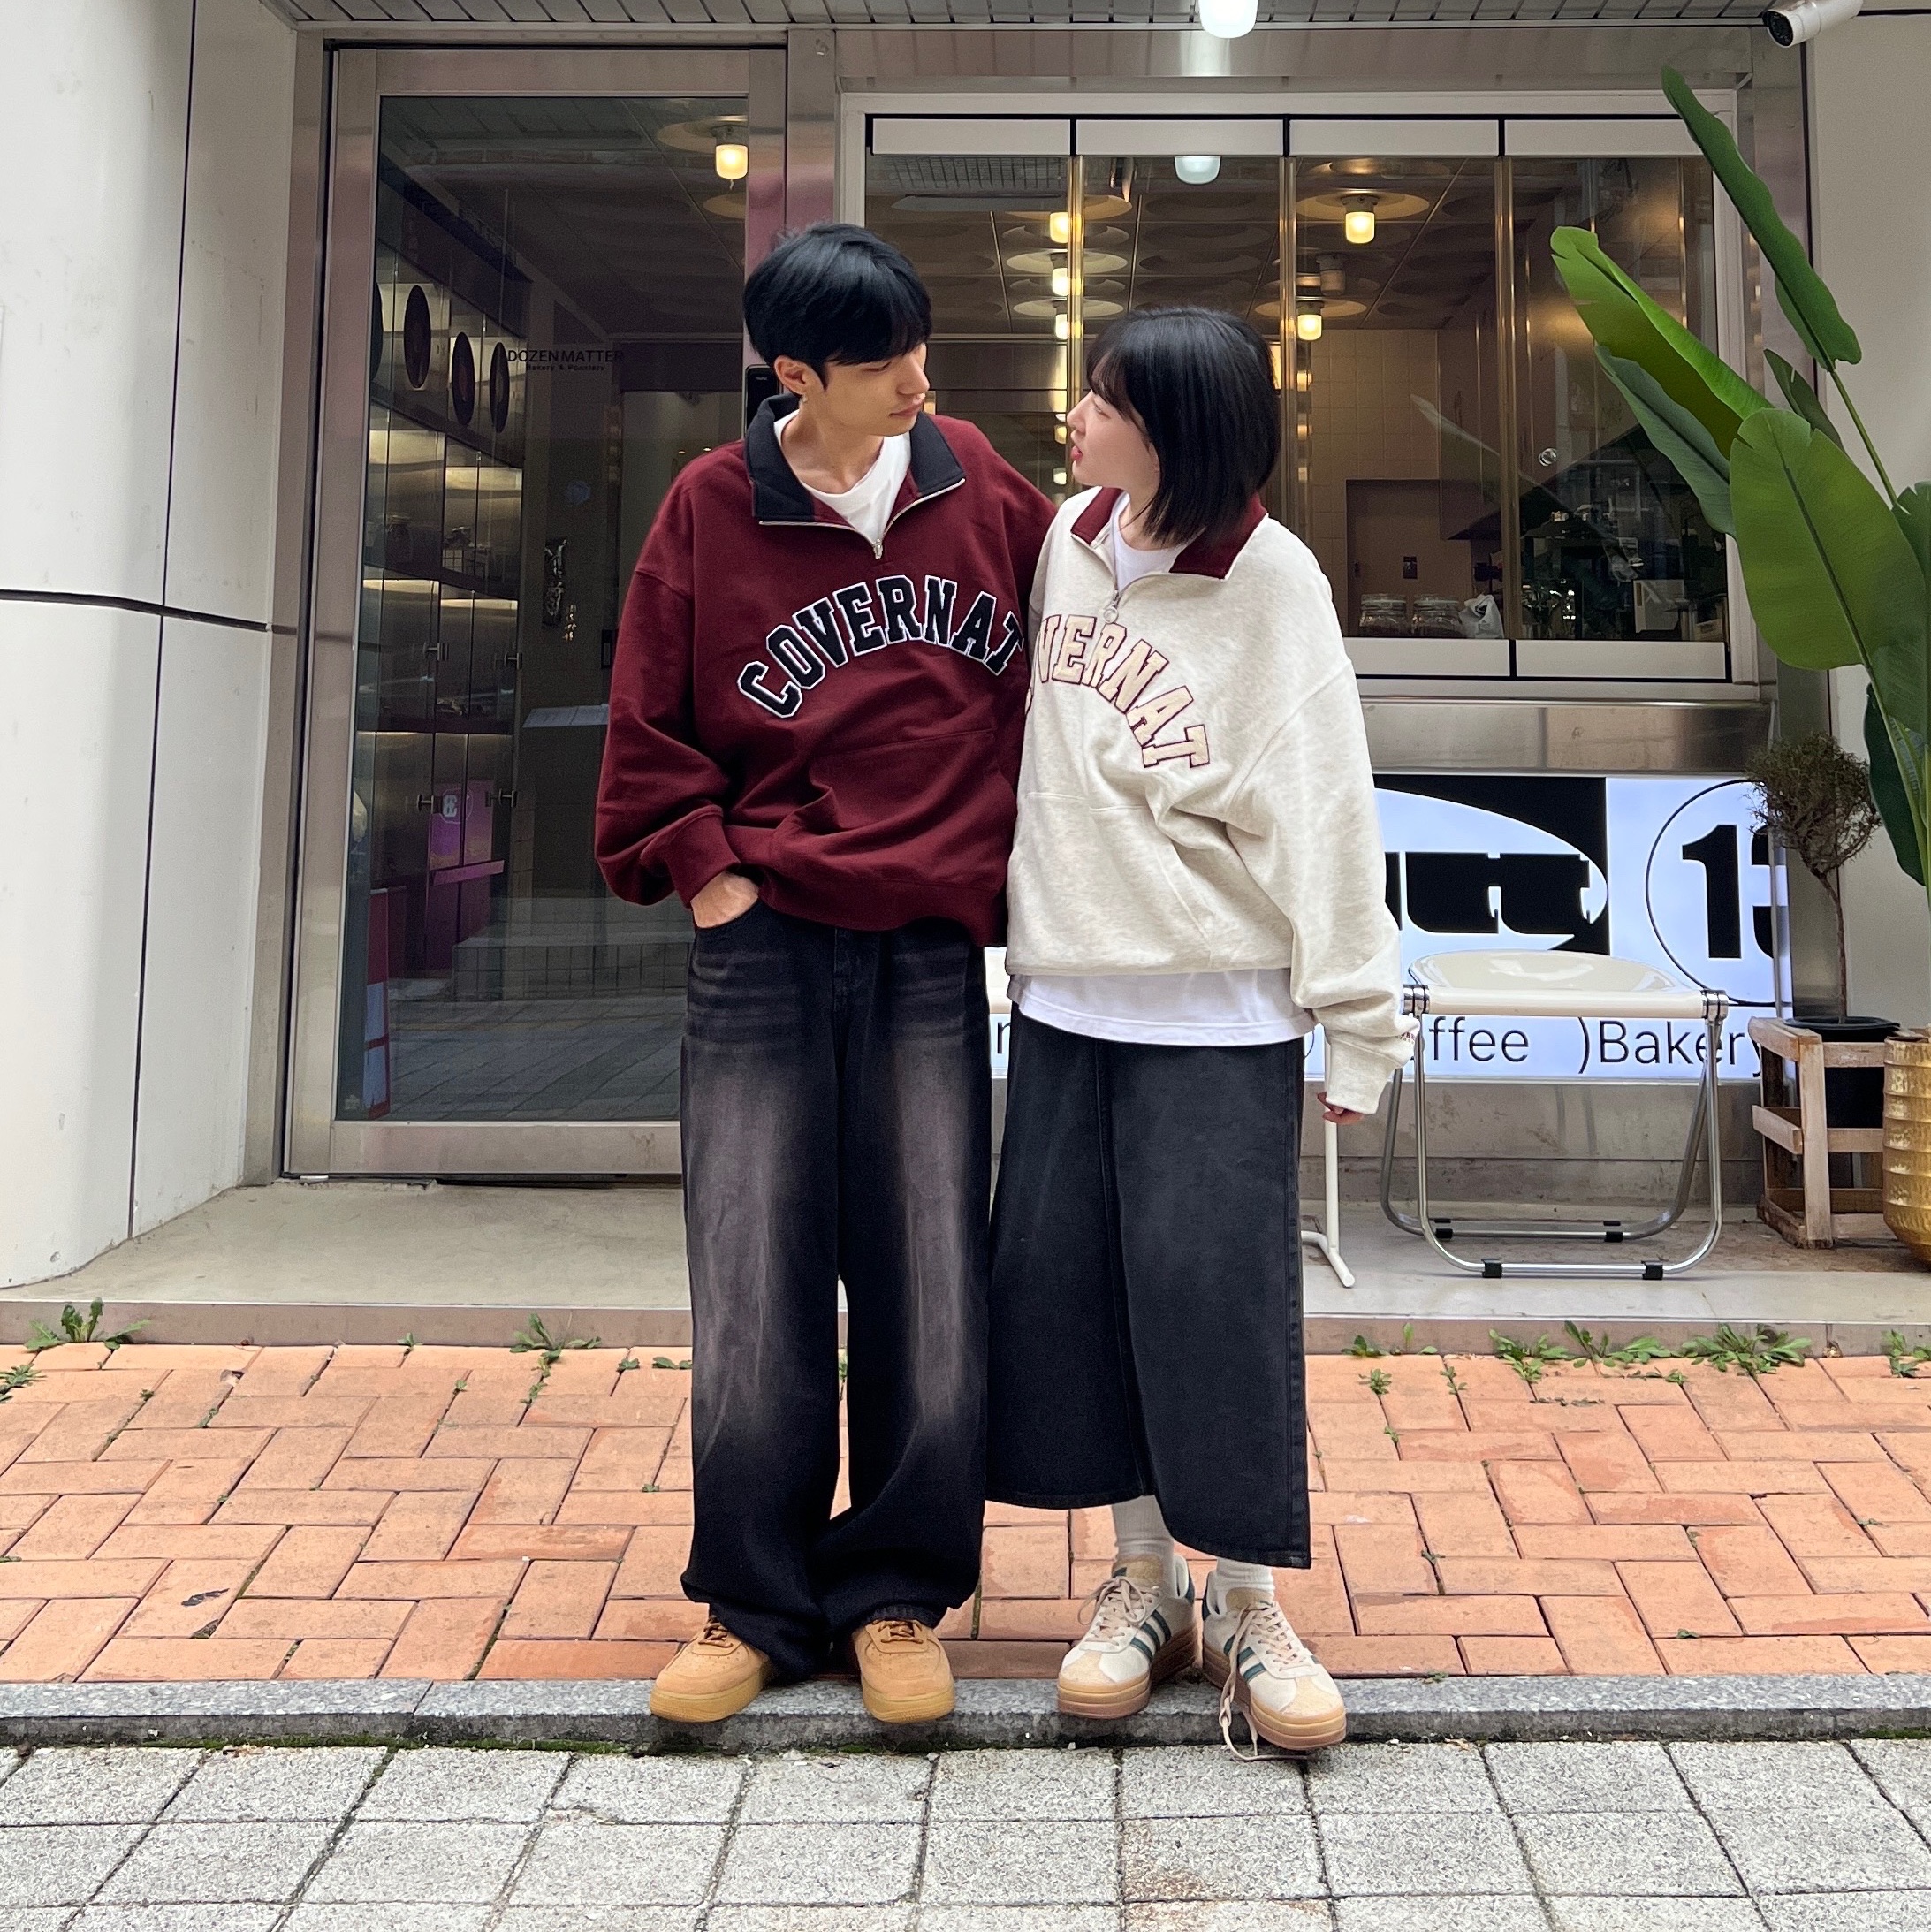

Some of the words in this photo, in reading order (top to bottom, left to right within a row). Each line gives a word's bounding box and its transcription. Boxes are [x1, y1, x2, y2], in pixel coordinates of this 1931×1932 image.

[737, 574, 1024, 719] COVERNAT
[1025, 614, 1211, 769] VERNAT
[1410, 1016, 1530, 1062] ffee
